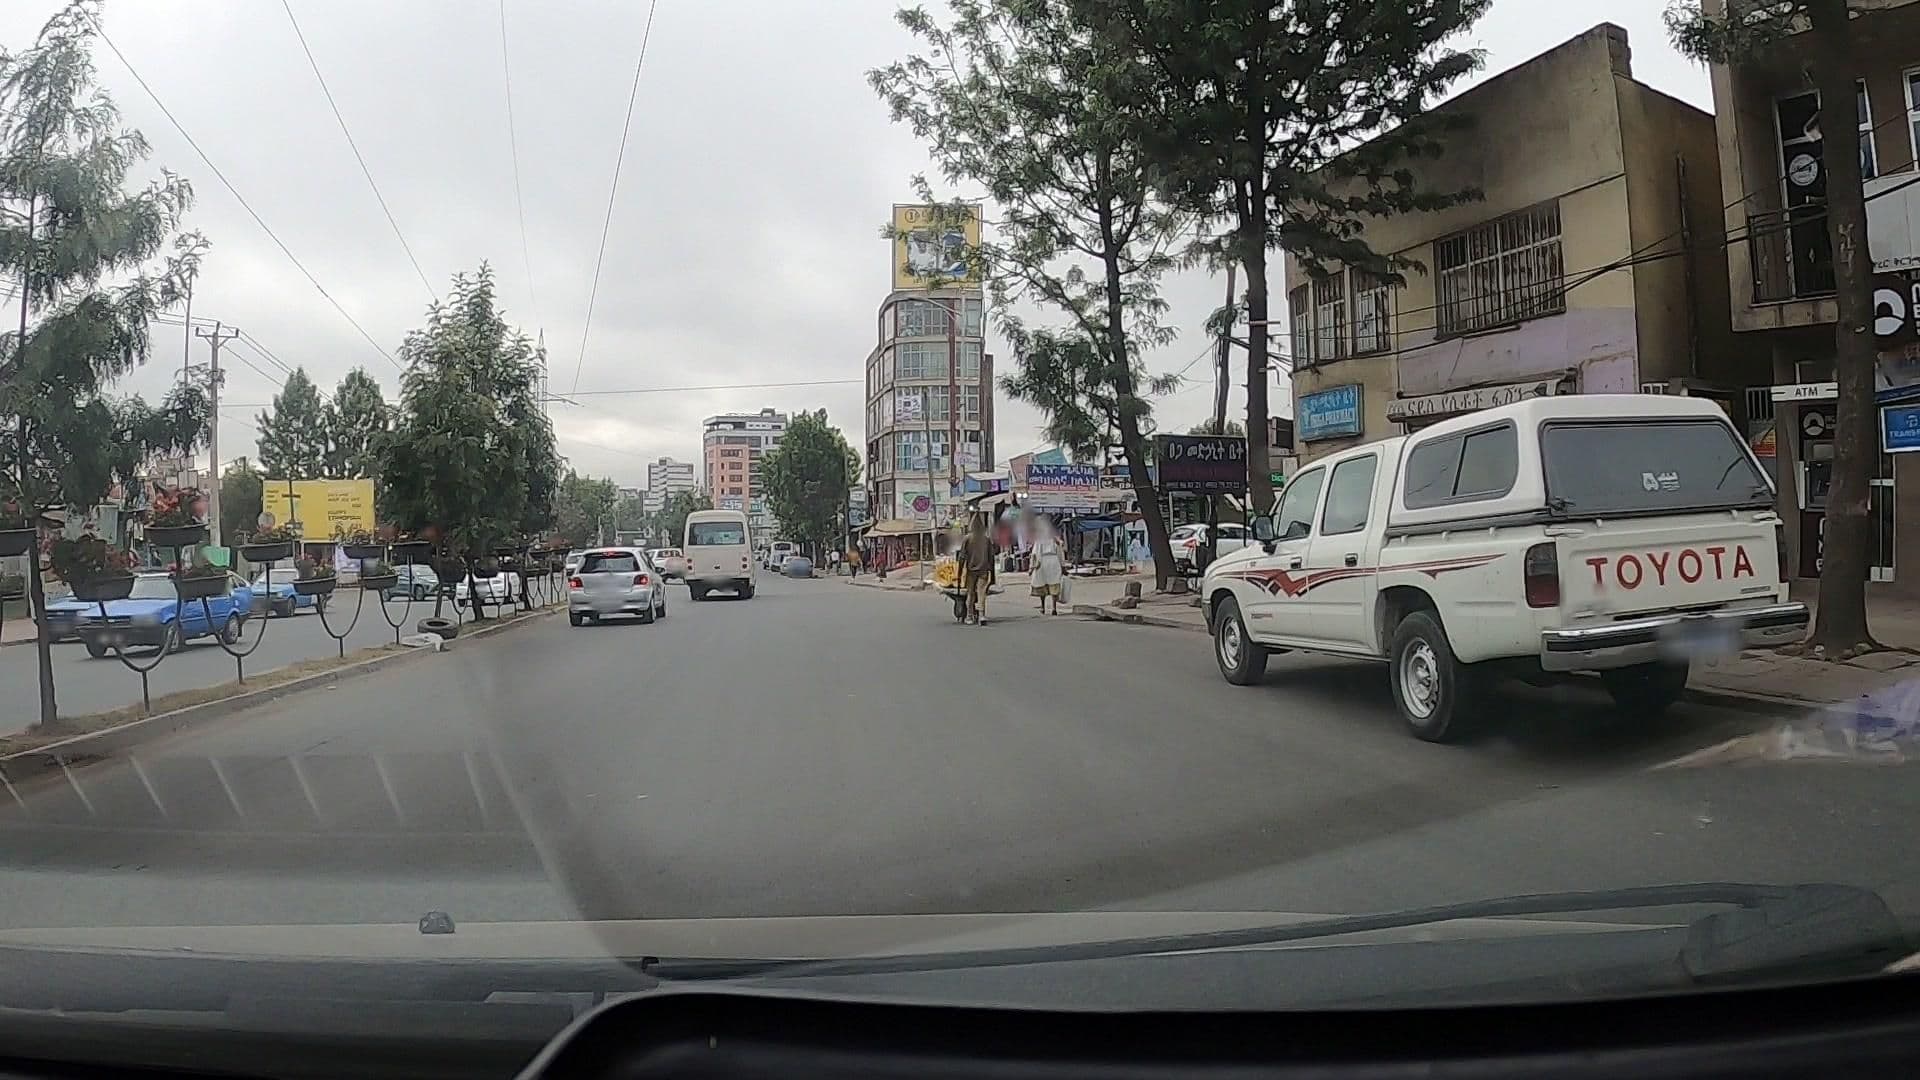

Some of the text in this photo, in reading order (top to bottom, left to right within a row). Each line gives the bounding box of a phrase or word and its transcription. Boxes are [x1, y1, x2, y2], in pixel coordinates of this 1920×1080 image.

[1795, 387, 1818, 397] ATM
[1229, 441, 1244, 460] ቤት
[1586, 545, 1754, 589] TOYOTA
